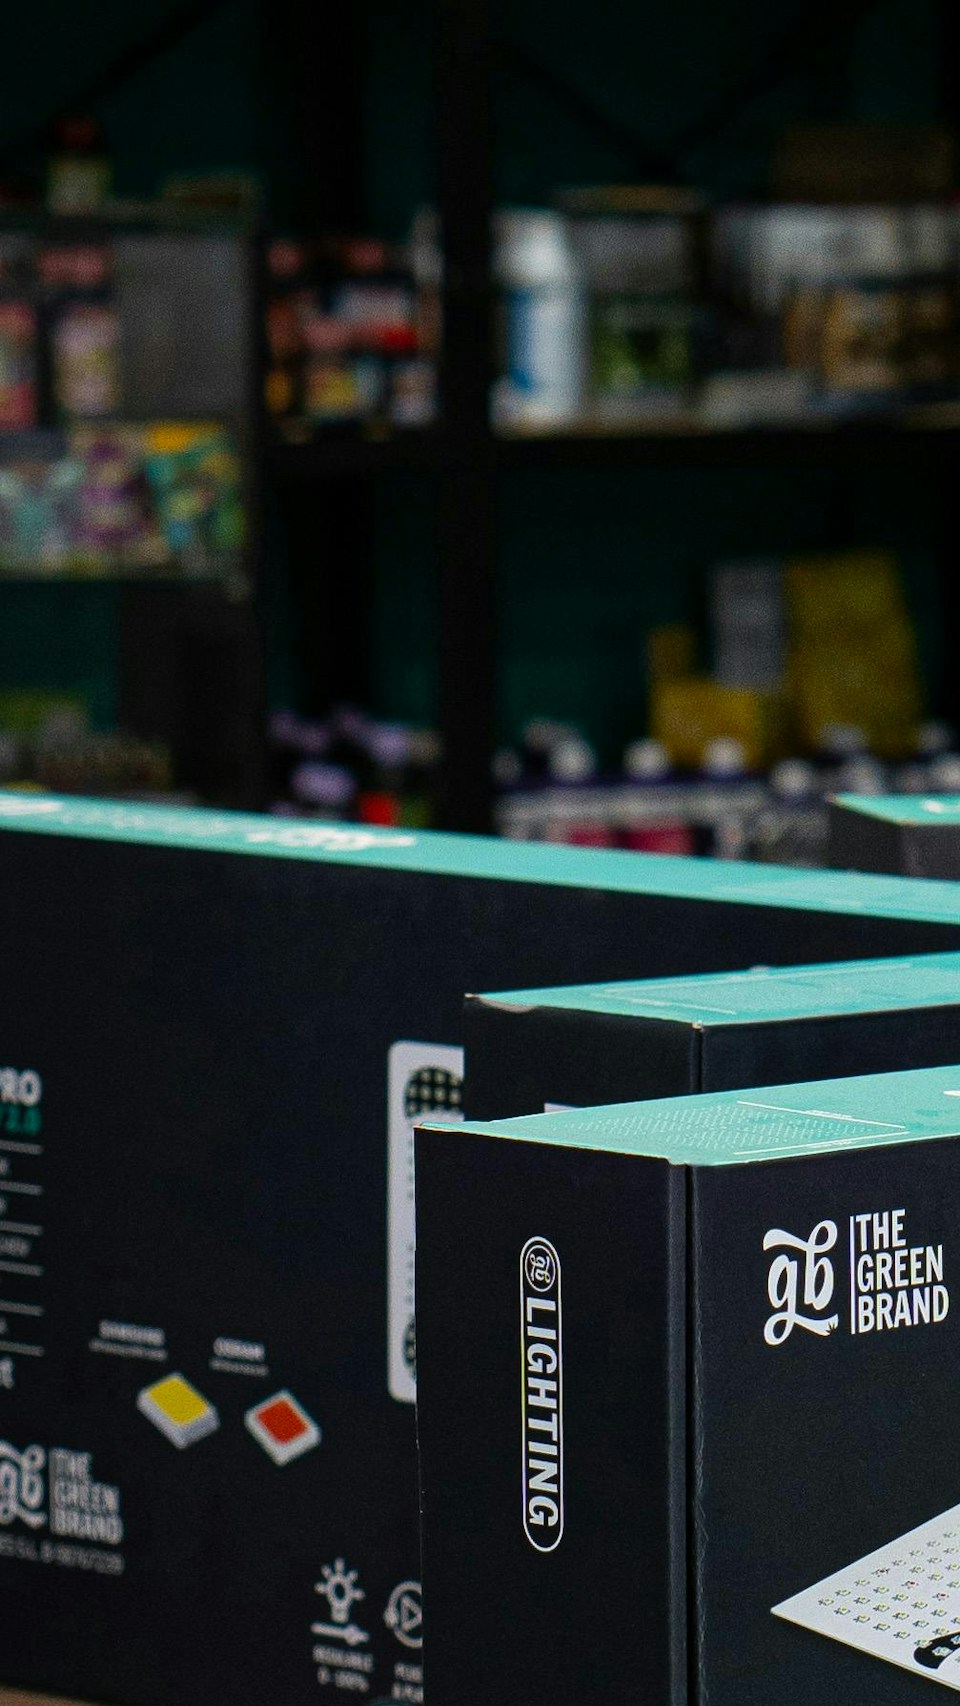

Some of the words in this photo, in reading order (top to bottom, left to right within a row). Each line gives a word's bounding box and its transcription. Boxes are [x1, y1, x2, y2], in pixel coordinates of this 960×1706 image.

[856, 1209, 906, 1252] THE
[857, 1244, 944, 1293] GREEN
[858, 1285, 950, 1334] BRAND
[526, 1297, 559, 1527] LIGHTING
